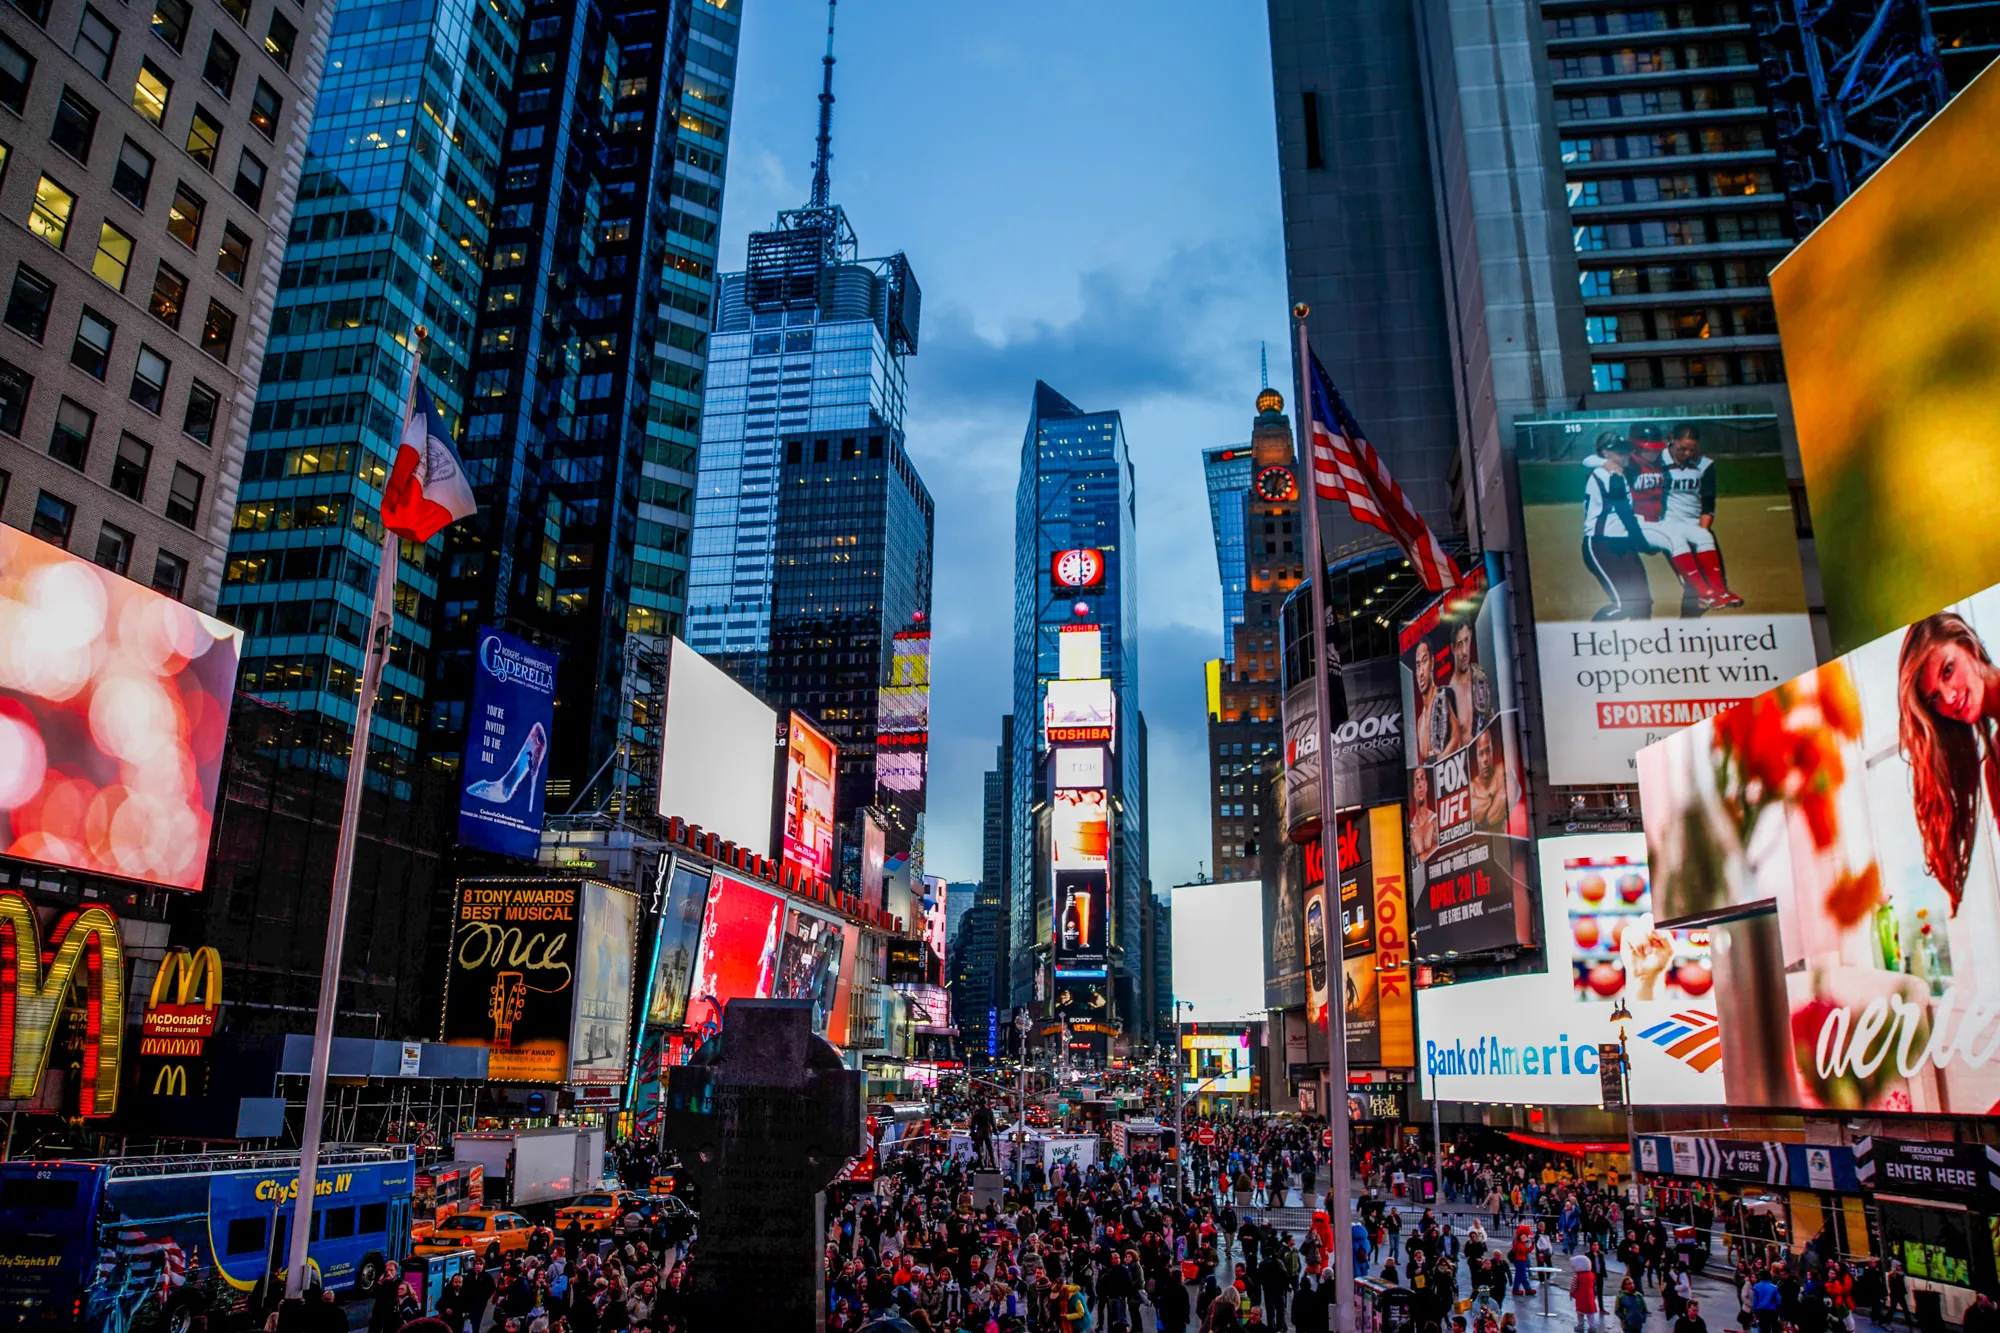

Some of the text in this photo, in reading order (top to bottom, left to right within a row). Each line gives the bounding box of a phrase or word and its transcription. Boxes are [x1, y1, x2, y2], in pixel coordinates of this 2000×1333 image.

[1060, 624, 1100, 632] TOSHIBA
[1571, 623, 1778, 662] Helped injured
[1576, 656, 1779, 694] opponent win.
[485, 719, 506, 736] INVITED
[1049, 728, 1110, 740] TOSHIBA
[483, 734, 501, 750] TO THE
[1342, 737, 1400, 755] emotion
[481, 750, 494, 764] BALL
[1072, 763, 1098, 772] TDK
[1435, 750, 1469, 799] FOX
[1440, 790, 1468, 827] UFC
[1440, 821, 1472, 843] SATURDAY
[463, 889, 575, 903] 8 TONY AWARDS
[1429, 879, 1457, 911] APRIL
[1457, 873, 1472, 902] 20
[461, 906, 573, 920] BEST MUSICAL
[1439, 910, 1448, 926] LIVE
[1451, 906, 1461, 923] FREE
[1469, 901, 1484, 918] FOX
[145, 1013, 212, 1025] McDonald's
[155, 1025, 199, 1033] Restaurant
[500, 1048, 529, 1056] GRAMMY
[1426, 1034, 1599, 1075] Bank of Americ
[1353, 1084, 1403, 1092] RQUIS
[1373, 1104, 1400, 1118] Hyde
[1051, 1143, 1082, 1156] Wear it.
[1737, 1151, 1762, 1162] WE'RE
[1900, 1145, 1955, 1157] AMERICAN EAGLE
[1738, 1162, 1760, 1173] OPEN
[1885, 1162, 1977, 1187] ENTER HERE
[334, 1173, 352, 1193] NY
